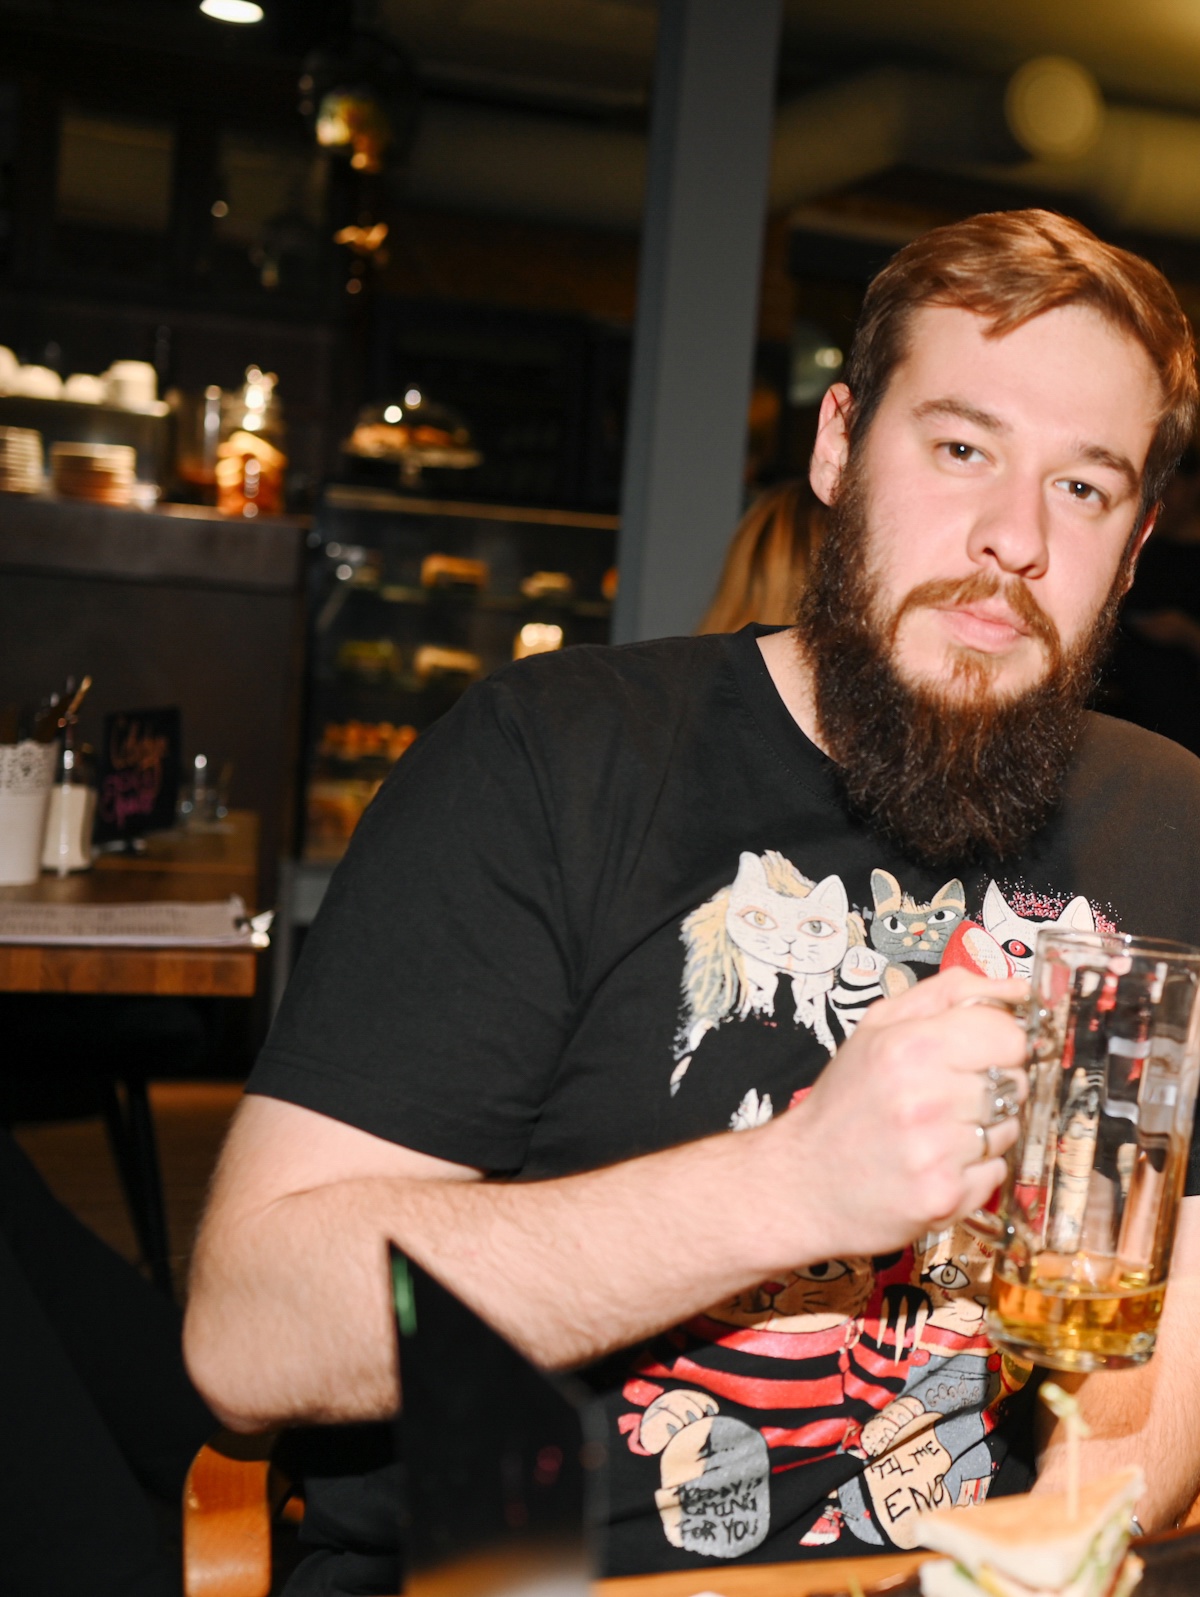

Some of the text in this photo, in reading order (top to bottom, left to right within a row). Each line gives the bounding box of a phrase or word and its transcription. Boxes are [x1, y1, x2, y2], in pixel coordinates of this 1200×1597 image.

[908, 1440, 941, 1466] THE
[884, 1474, 944, 1523] END
[674, 1519, 717, 1541] FOR
